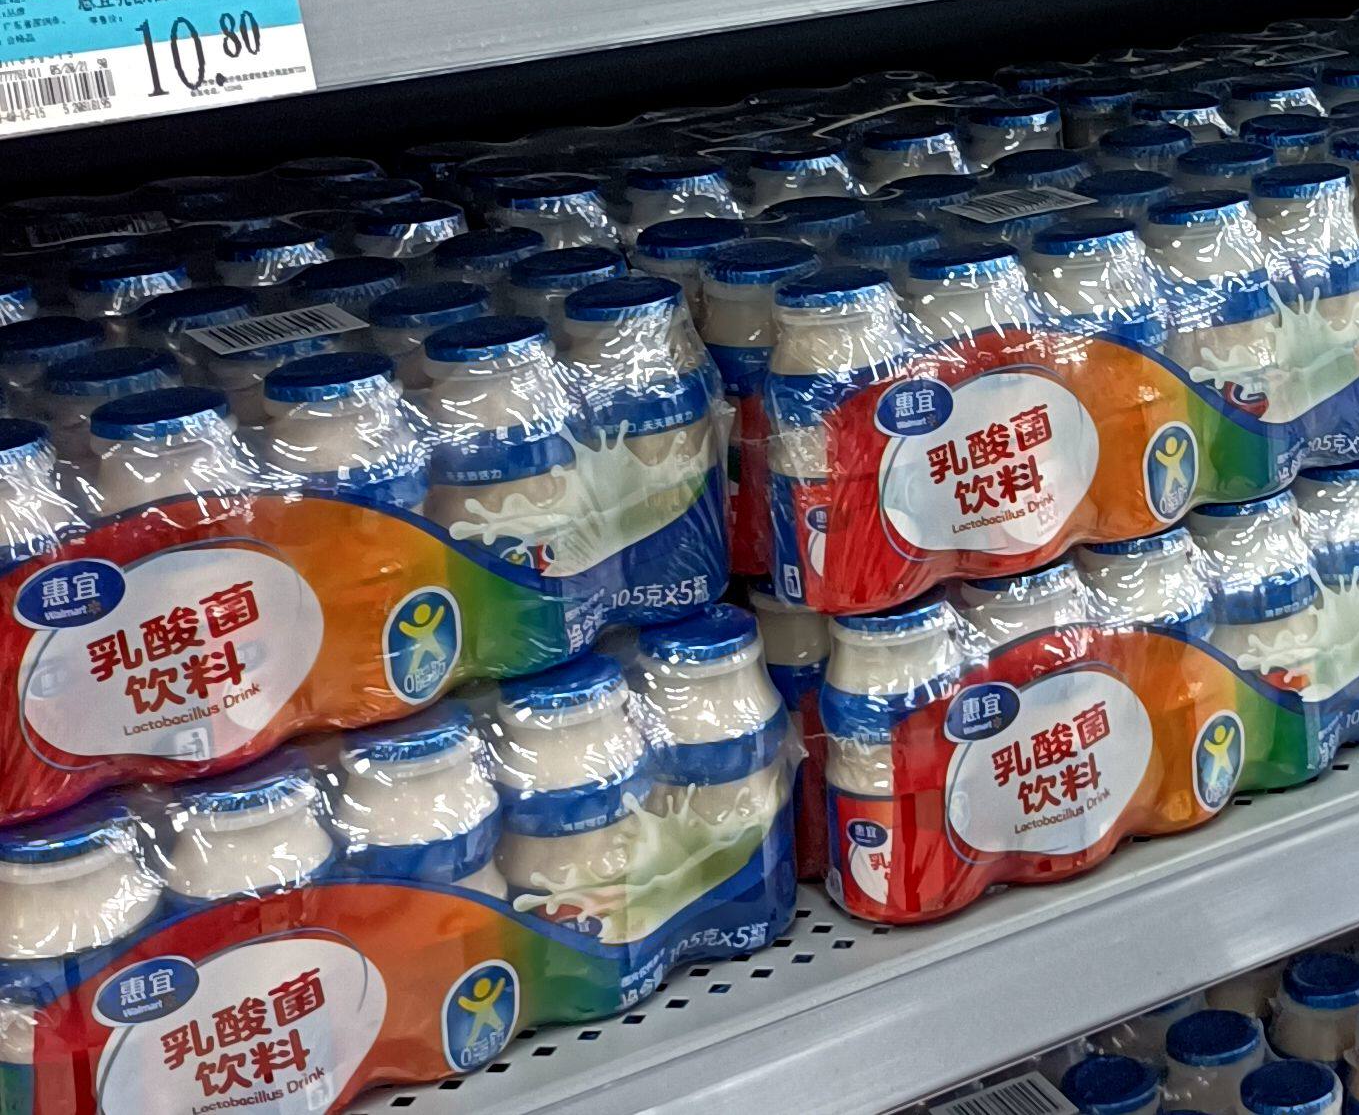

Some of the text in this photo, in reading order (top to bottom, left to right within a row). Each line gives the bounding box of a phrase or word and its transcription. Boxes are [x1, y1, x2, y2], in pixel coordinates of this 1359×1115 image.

[135, 10, 261, 98] 10.80
[895, 388, 935, 419] 惠宜
[926, 403, 1054, 485] 乳酸菌
[951, 494, 1056, 535] Lactobacillus Drink
[953, 455, 1044, 516] 饮料
[41, 571, 101, 608] 惠宜
[86, 580, 261, 683] 乳酸菌
[124, 641, 247, 716] 饮料
[962, 692, 1002, 725] 惠宜
[123, 684, 262, 737] Lactobacillus Drink
[991, 700, 1112, 790] 乳酸菌
[1014, 787, 1112, 835] Lactobacillus Drink
[1017, 752, 1102, 816] 饮料
[118, 968, 175, 1005] 惠宜
[161, 968, 326, 1072] 乳酸菌
[194, 1028, 312, 1099] 饮料
[287, 1066, 326, 1094] Drink
